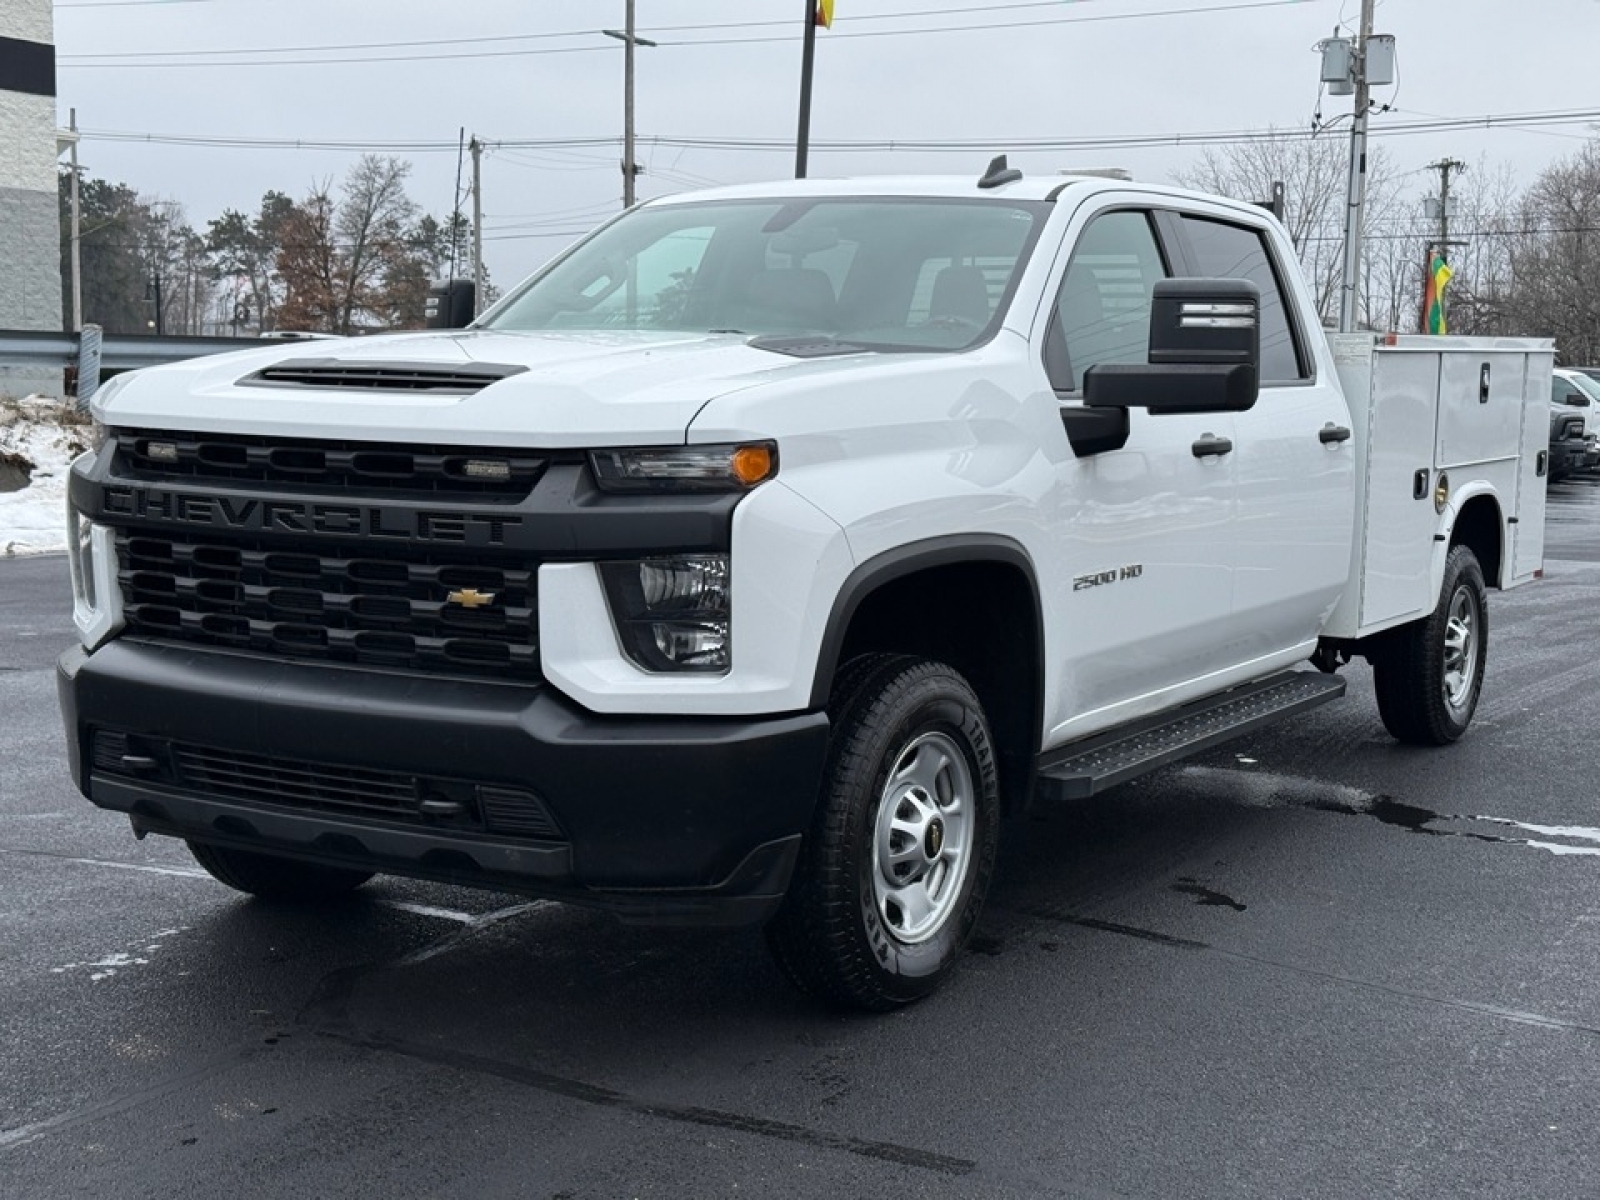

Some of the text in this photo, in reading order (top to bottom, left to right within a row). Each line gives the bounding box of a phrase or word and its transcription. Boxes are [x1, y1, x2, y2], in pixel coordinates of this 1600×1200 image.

[102, 486, 523, 545] CHEVROLET
[1073, 564, 1142, 591] 2500 HD
